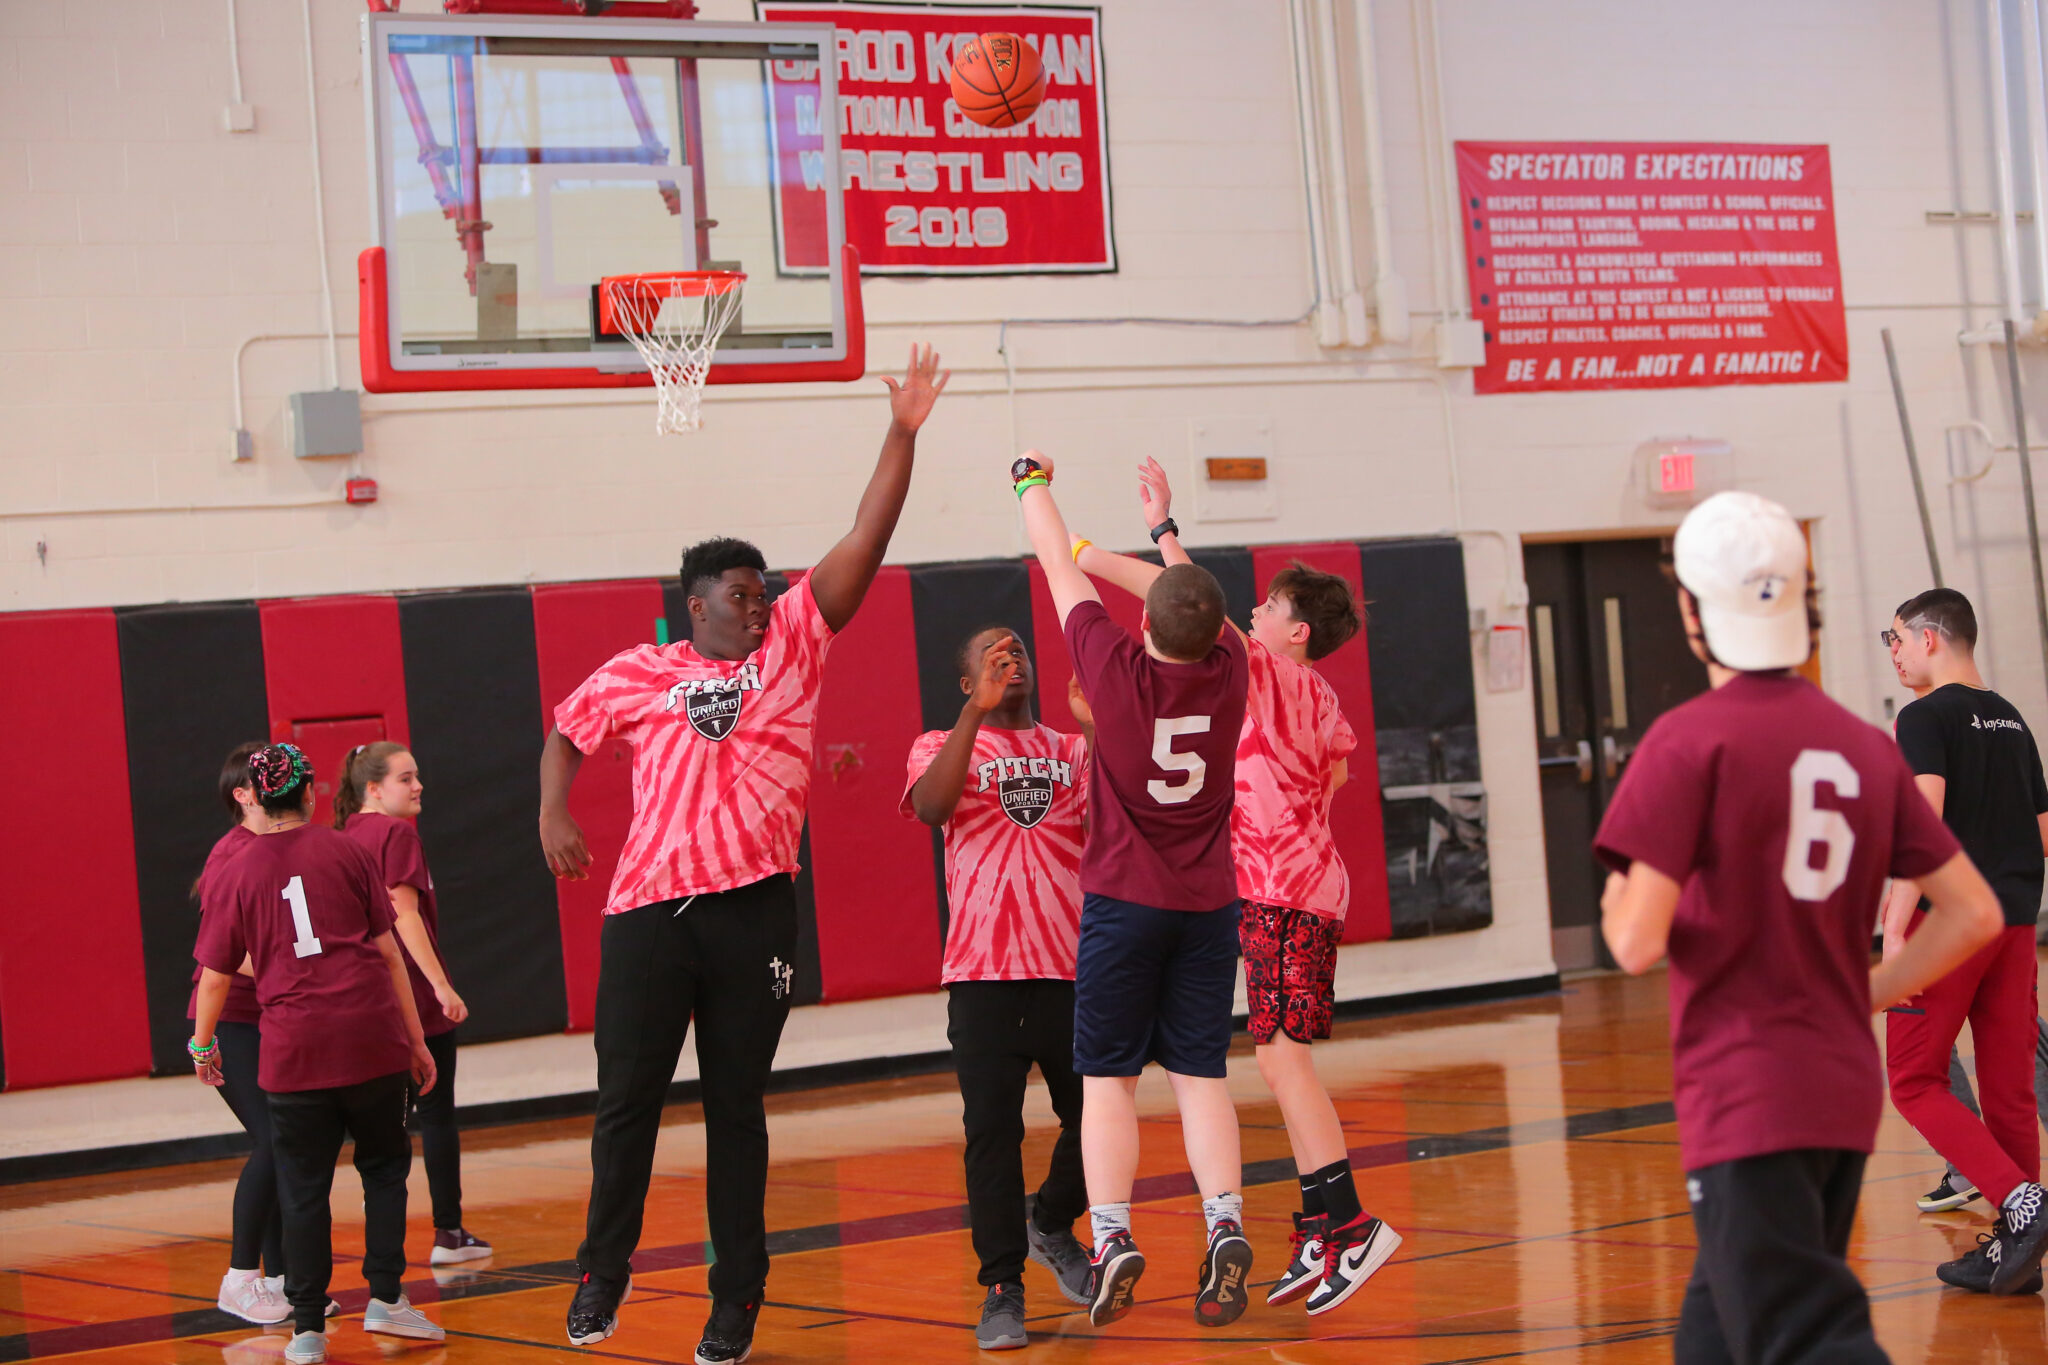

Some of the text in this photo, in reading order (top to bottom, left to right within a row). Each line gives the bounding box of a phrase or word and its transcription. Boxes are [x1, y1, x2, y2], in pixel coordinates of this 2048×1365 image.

[1488, 153, 1804, 181] SPECTATOR EXPECTATIONS
[885, 205, 1008, 247] 2018
[1506, 359, 1537, 382] BE
[1545, 358, 1561, 381] A
[1688, 353, 1705, 376] A
[1713, 351, 1804, 375] FANATIC
[691, 700, 737, 718] UNIFIED
[702, 709, 728, 719] SPORTS
[977, 756, 1072, 793] FITCH
[1147, 715, 1211, 804] 5
[1004, 791, 1049, 804] UNIFIED
[1782, 748, 1860, 902] 6
[281, 875, 322, 958] 1
[1217, 1262, 1242, 1303] FILA
